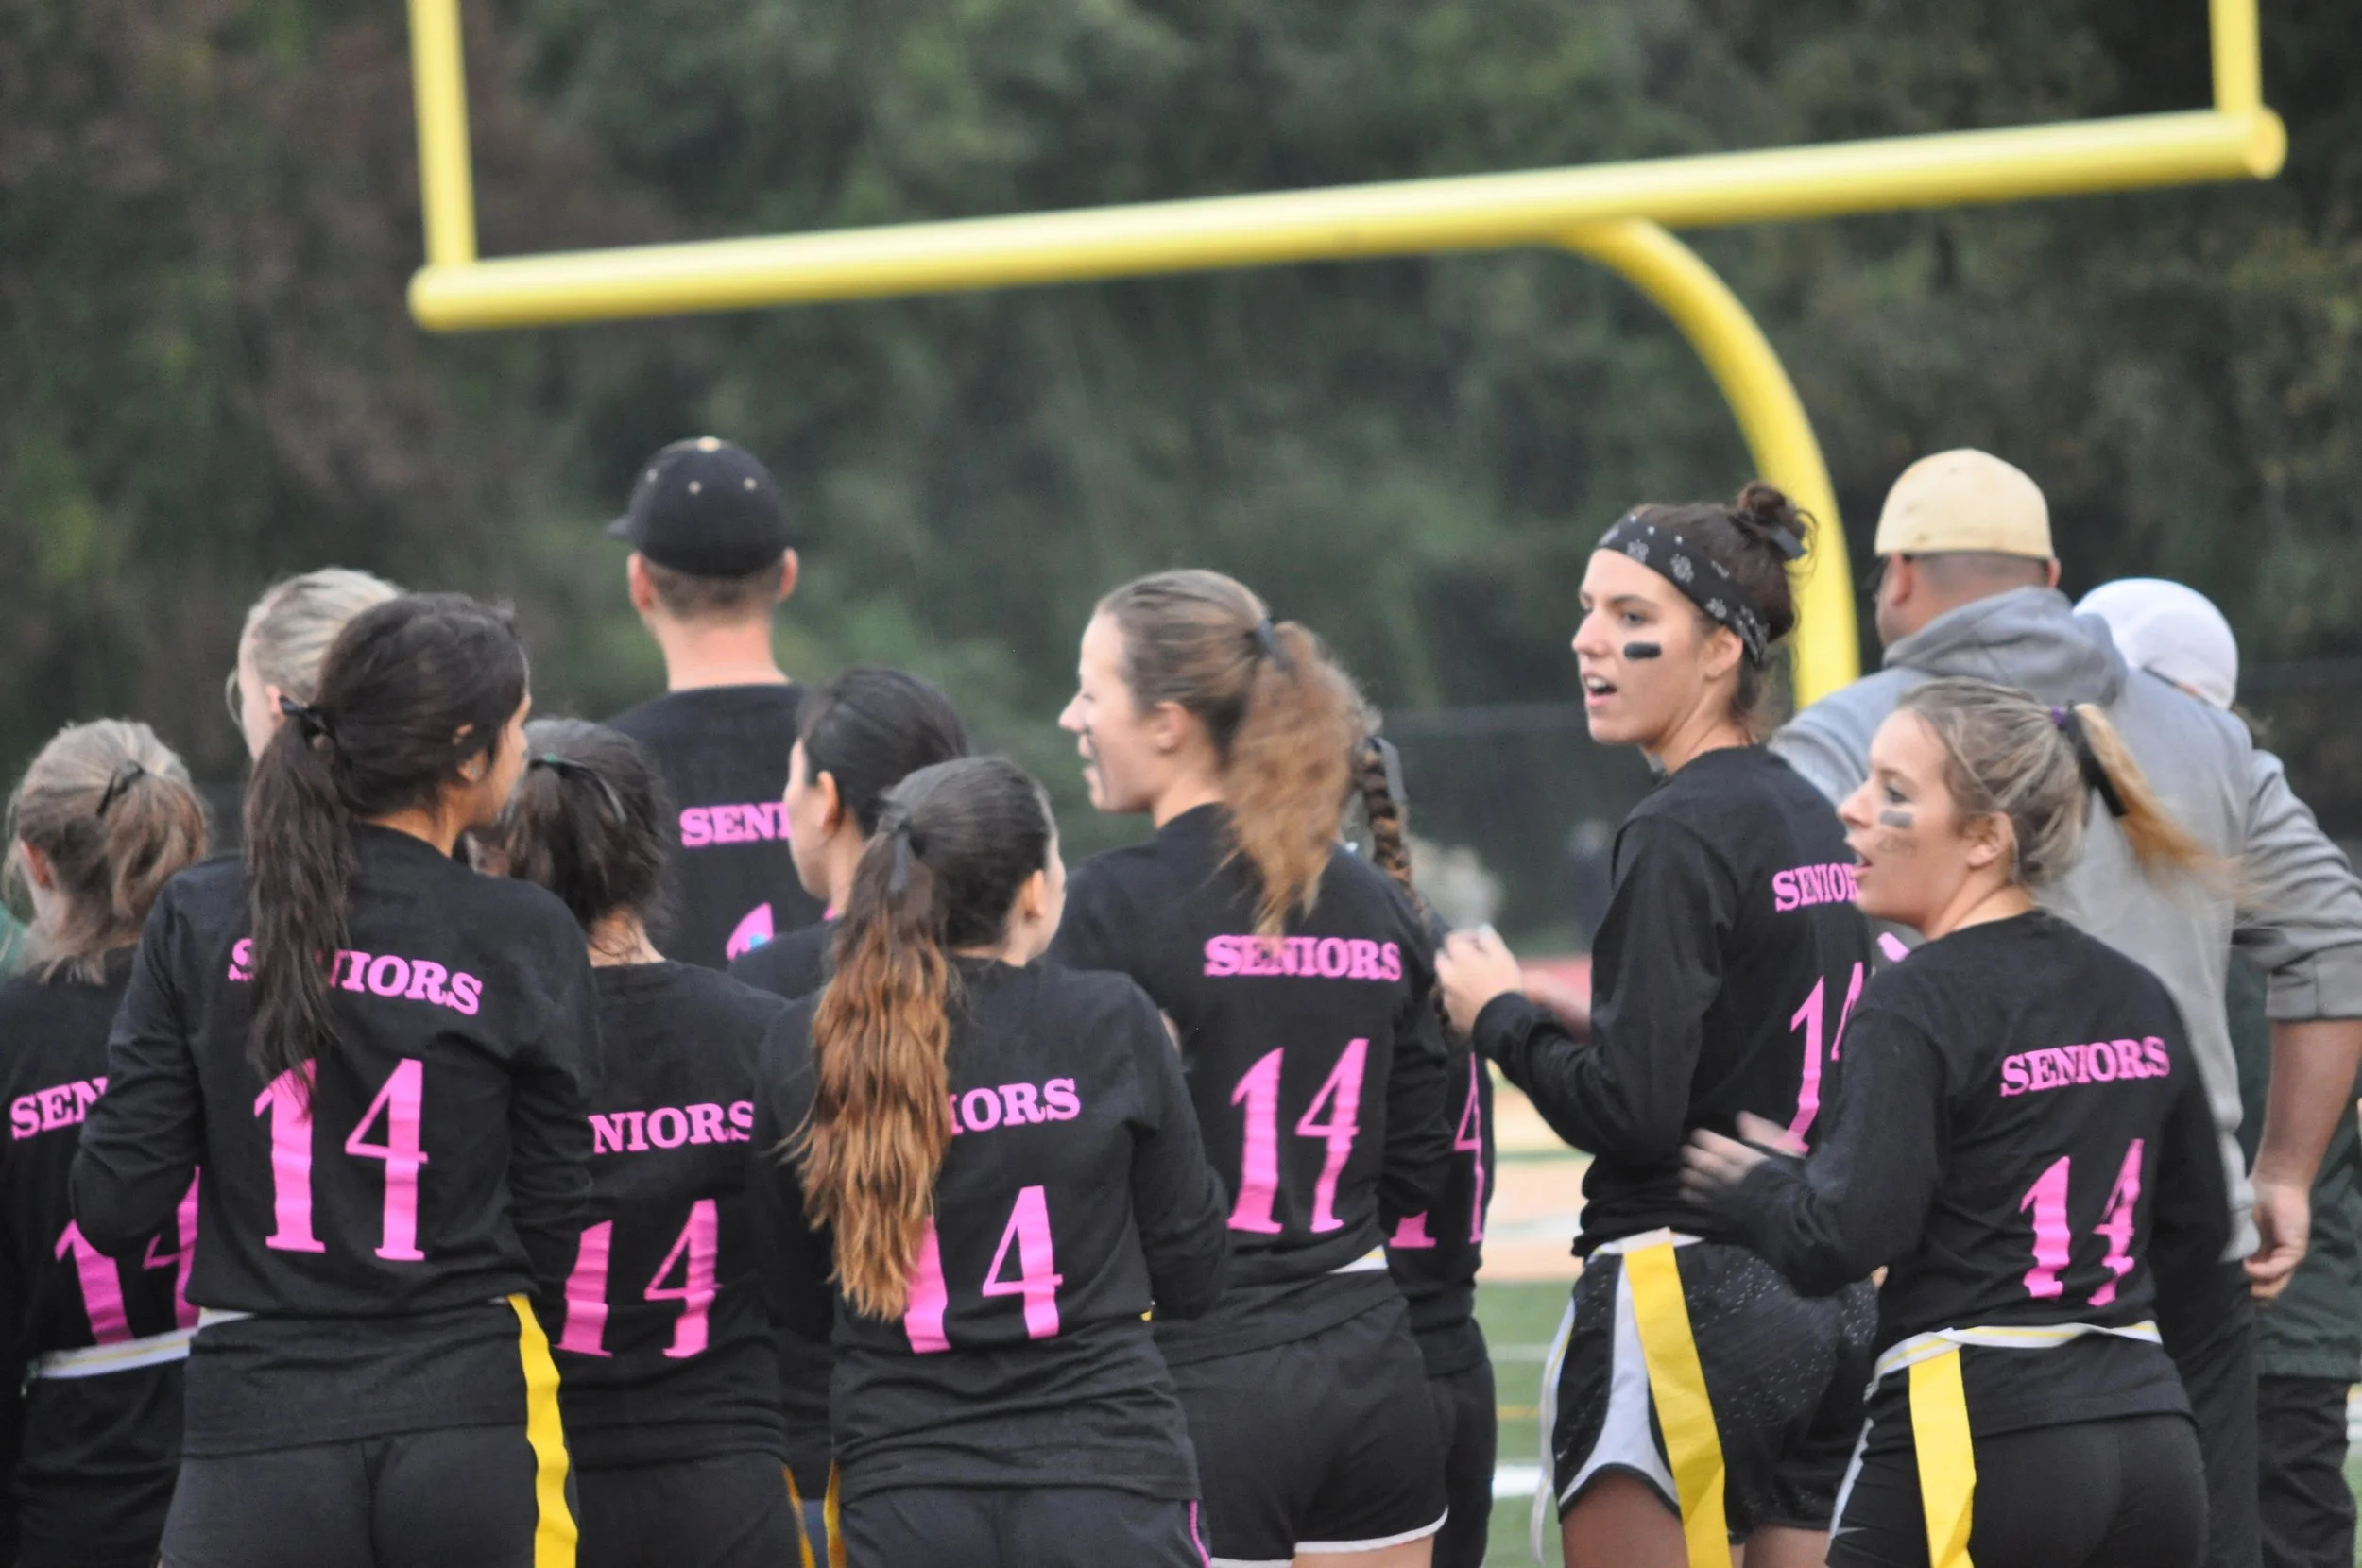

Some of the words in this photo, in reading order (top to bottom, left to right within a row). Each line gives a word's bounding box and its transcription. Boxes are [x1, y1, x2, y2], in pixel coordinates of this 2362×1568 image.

[228, 938, 483, 1015] SIORS
[1204, 934, 1402, 981] SENIORS
[1226, 1038, 1369, 1235] 14
[2001, 1036, 2170, 1097] SENIORS
[254, 1058, 428, 1261] 14
[2020, 1138, 2144, 1307] 14
[556, 1199, 724, 1358] 14
